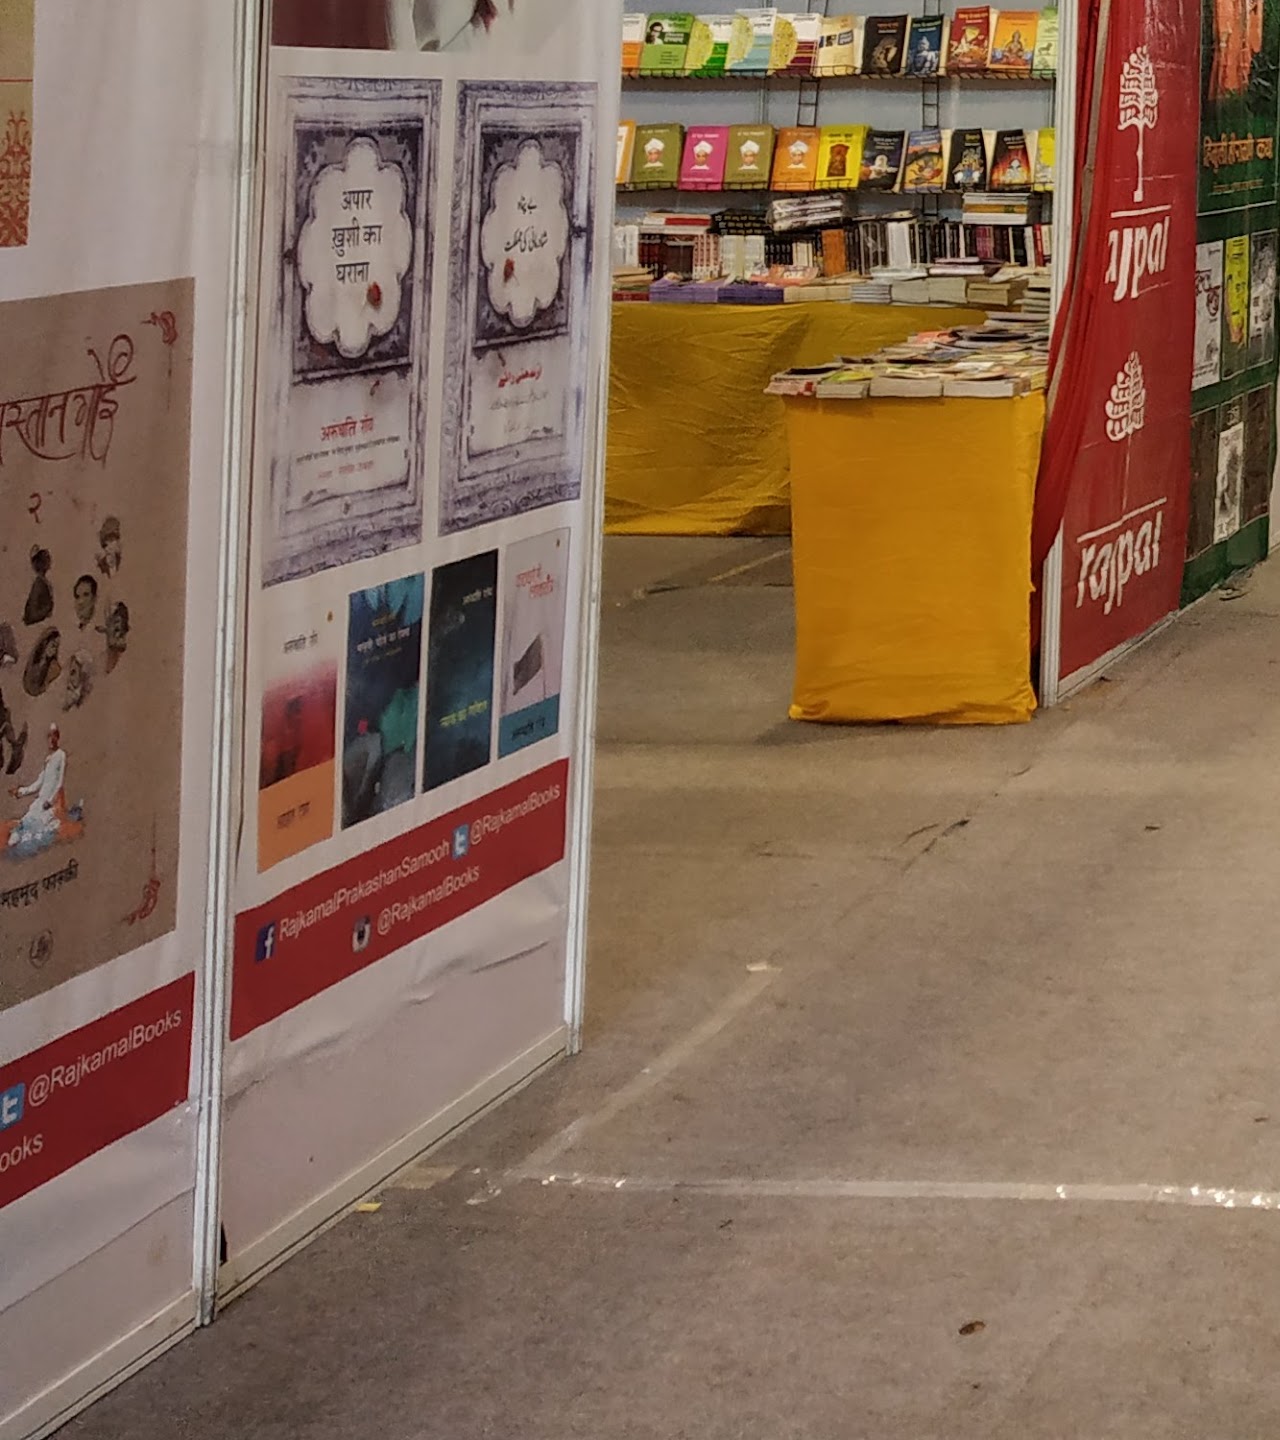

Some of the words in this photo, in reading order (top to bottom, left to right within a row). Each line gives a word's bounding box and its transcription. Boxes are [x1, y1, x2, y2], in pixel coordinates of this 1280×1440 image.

[341, 189, 374, 210] अपार
[362, 225, 383, 245] का
[335, 262, 370, 285] घराना
[1076, 510, 1164, 614] rajpal
[279, 839, 449, 940] RajkamalPrakashanSamooh
[469, 784, 561, 845] @RajkamalBooks
[377, 865, 480, 935] @RajkamalBooks
[28, 1010, 182, 1108] @RajkamalBooks
